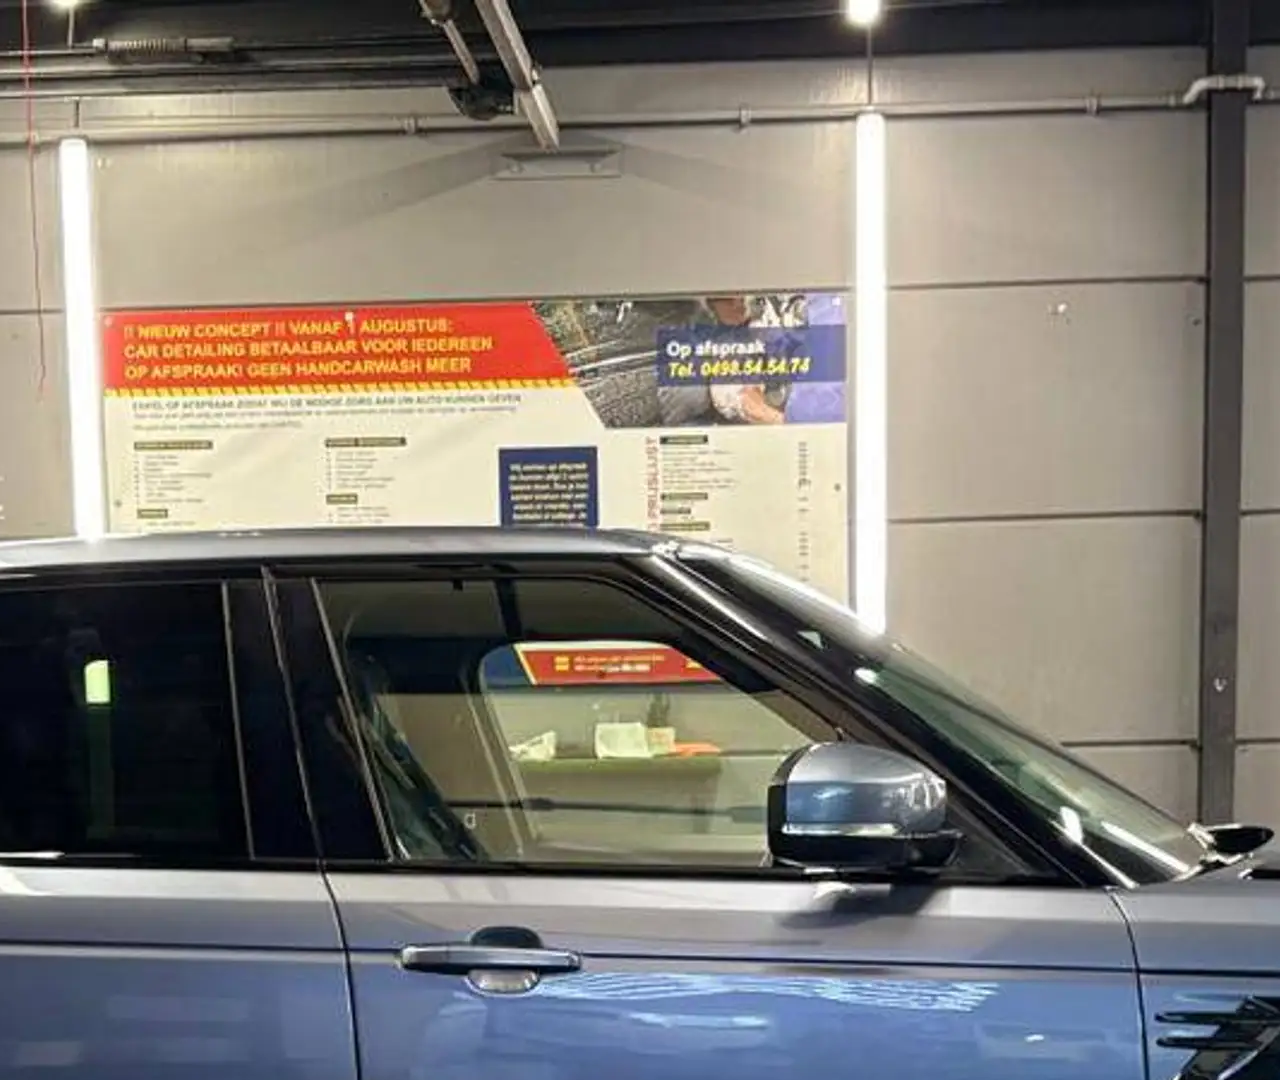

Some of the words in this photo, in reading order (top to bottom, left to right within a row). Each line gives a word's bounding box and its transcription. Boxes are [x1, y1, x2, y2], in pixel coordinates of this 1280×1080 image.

[138, 324, 190, 338] NIEUW
[193, 323, 270, 338] CONCEPT
[288, 320, 342, 336] VANAF
[360, 318, 455, 334] AUGUSTUS:
[124, 343, 160, 359] CAR
[162, 342, 246, 358] DETAILING
[249, 340, 358, 357] BETAALBAAR
[361, 338, 409, 354] VOOR
[411, 336, 494, 352] IEDEREEN
[666, 340, 692, 360] Op
[695, 338, 766, 358] afspraak
[125, 364, 148, 379] OP
[247, 361, 292, 377] GEEN
[296, 358, 421, 376] HANDCARWASH
[426, 356, 472, 373] MEER
[669, 362, 696, 377] Tel.
